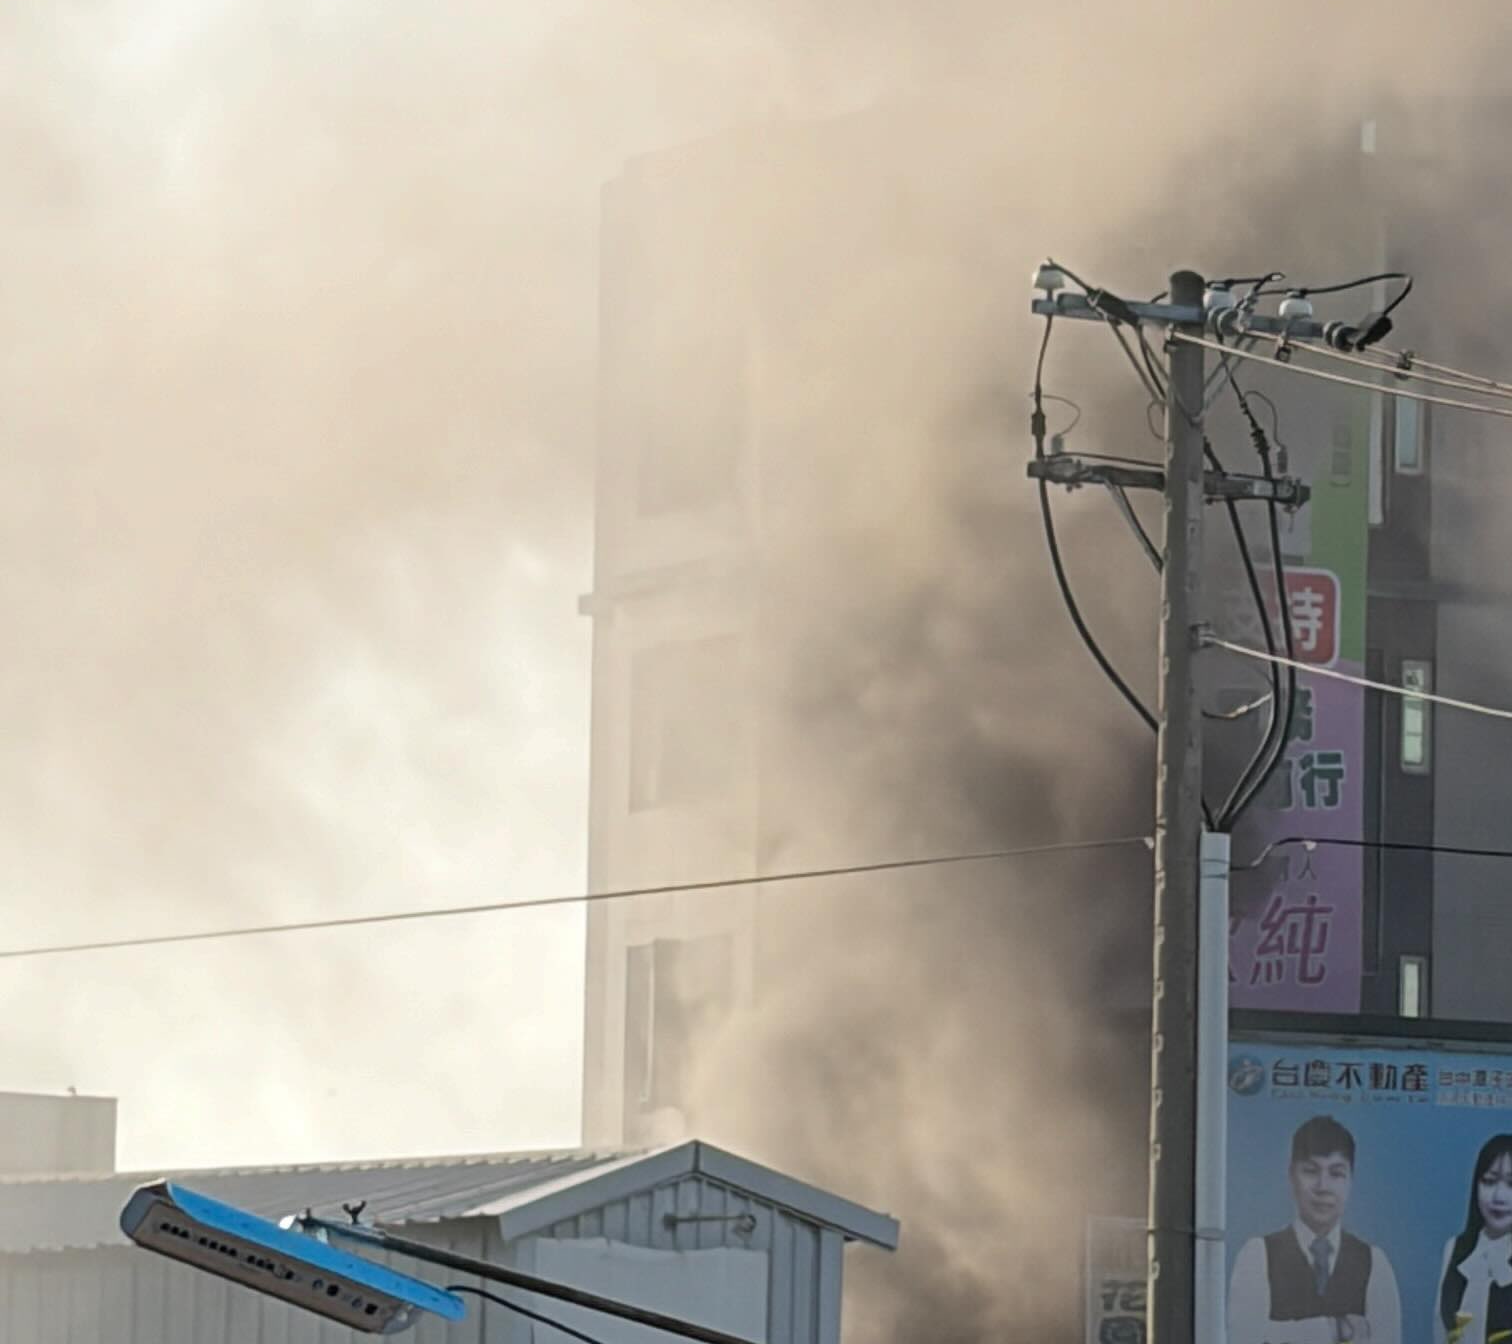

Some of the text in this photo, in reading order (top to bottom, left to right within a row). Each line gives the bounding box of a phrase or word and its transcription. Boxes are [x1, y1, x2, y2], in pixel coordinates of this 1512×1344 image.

[1271, 1056, 1430, 1092] 台慶不動產
